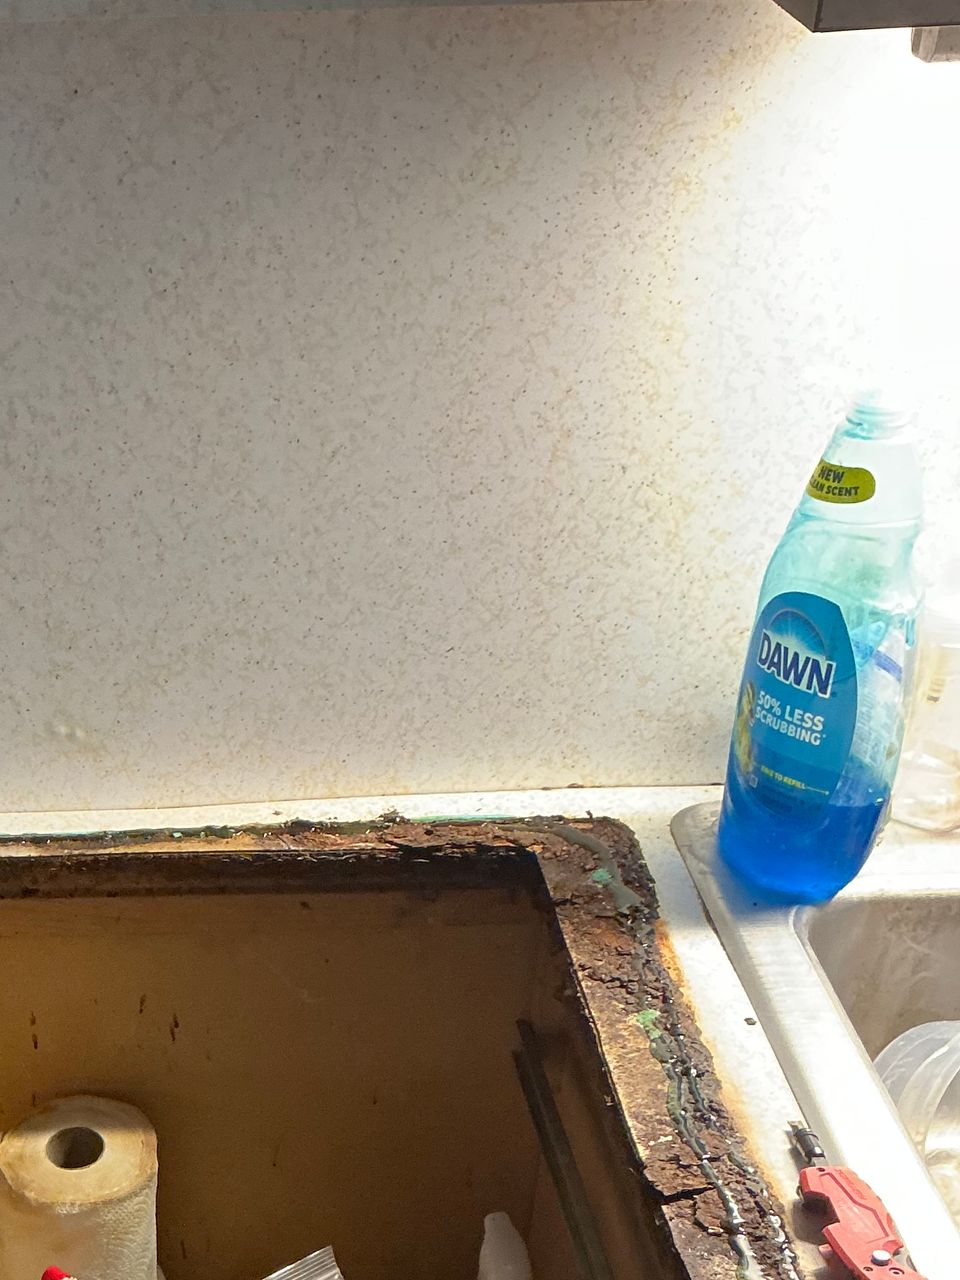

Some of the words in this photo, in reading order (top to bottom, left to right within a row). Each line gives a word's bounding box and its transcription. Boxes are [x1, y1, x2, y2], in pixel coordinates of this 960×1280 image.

[818, 466, 845, 484] NEW
[825, 485, 860, 497] SCENT
[758, 631, 835, 697] DAWN
[755, 706, 821, 746] SCRUBBING
[757, 691, 782, 716] 50%
[784, 705, 825, 732] LESS
